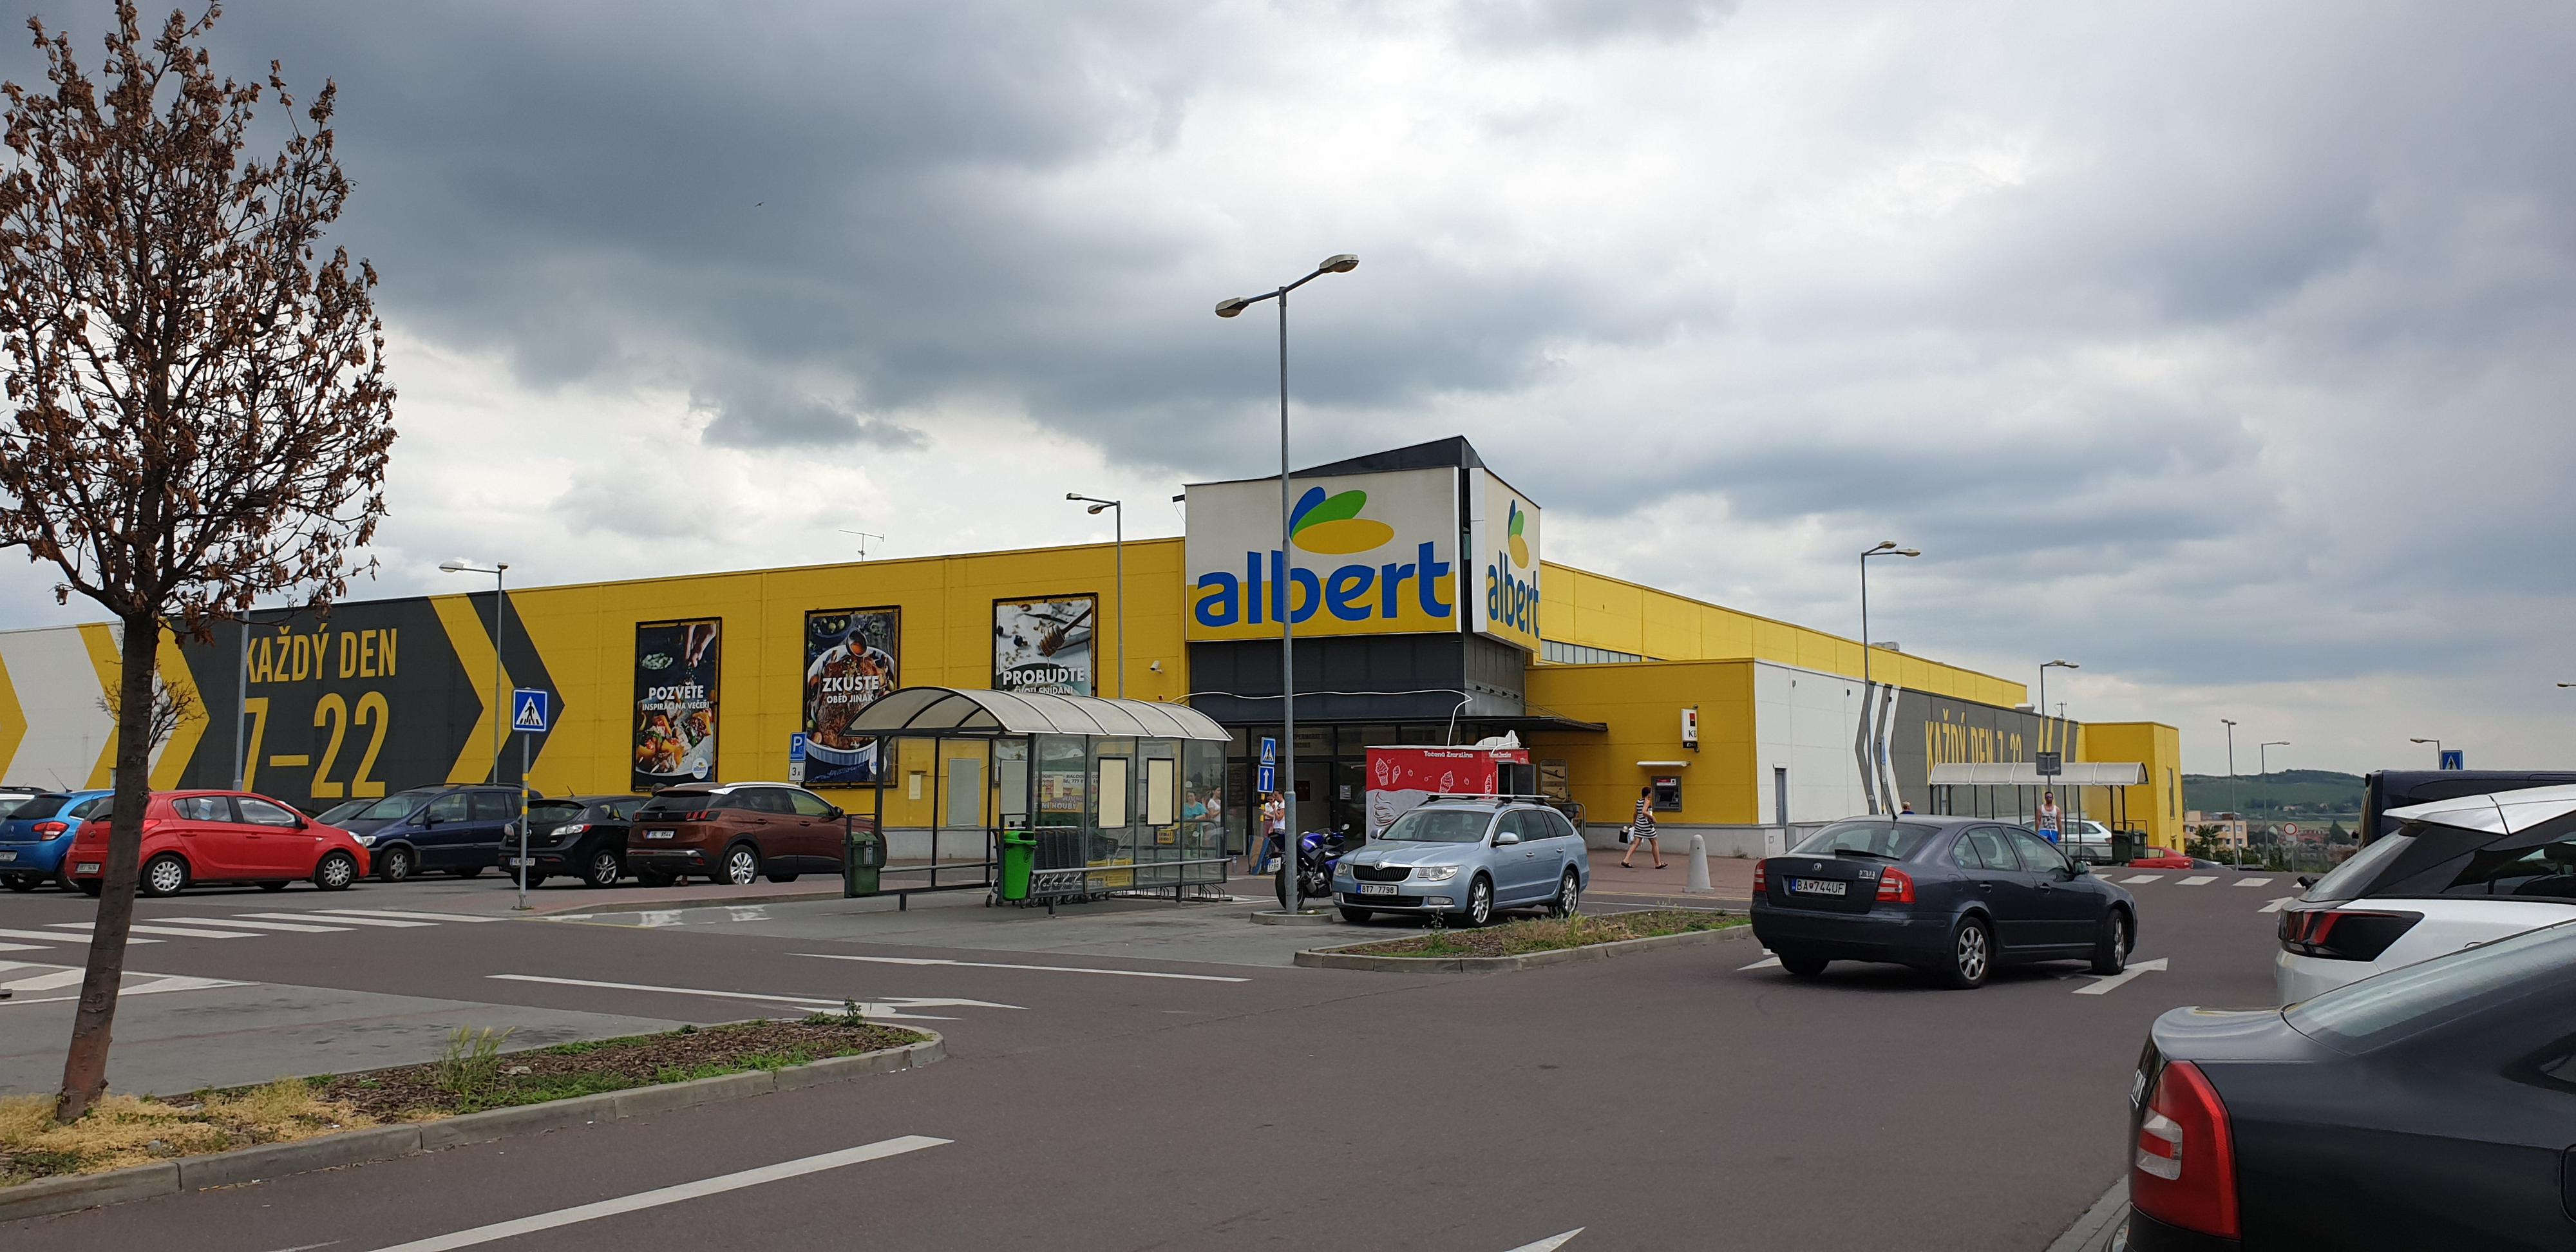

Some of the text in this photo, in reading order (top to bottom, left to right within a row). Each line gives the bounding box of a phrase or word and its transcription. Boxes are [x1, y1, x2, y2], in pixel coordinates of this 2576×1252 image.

[1195, 541, 1452, 627] albert
[1488, 549, 1540, 640] albert
[247, 623, 397, 683] KAŽDÝ DEN
[1003, 664, 1084, 685] PROBUĎTE
[649, 681, 704, 700] POZVĚTE
[826, 694, 874, 704] OBĚD JINAK
[793, 736, 803, 752] P
[1361, 885, 1373, 893] 8T7
[1797, 880, 1844, 893] BA 744UF
